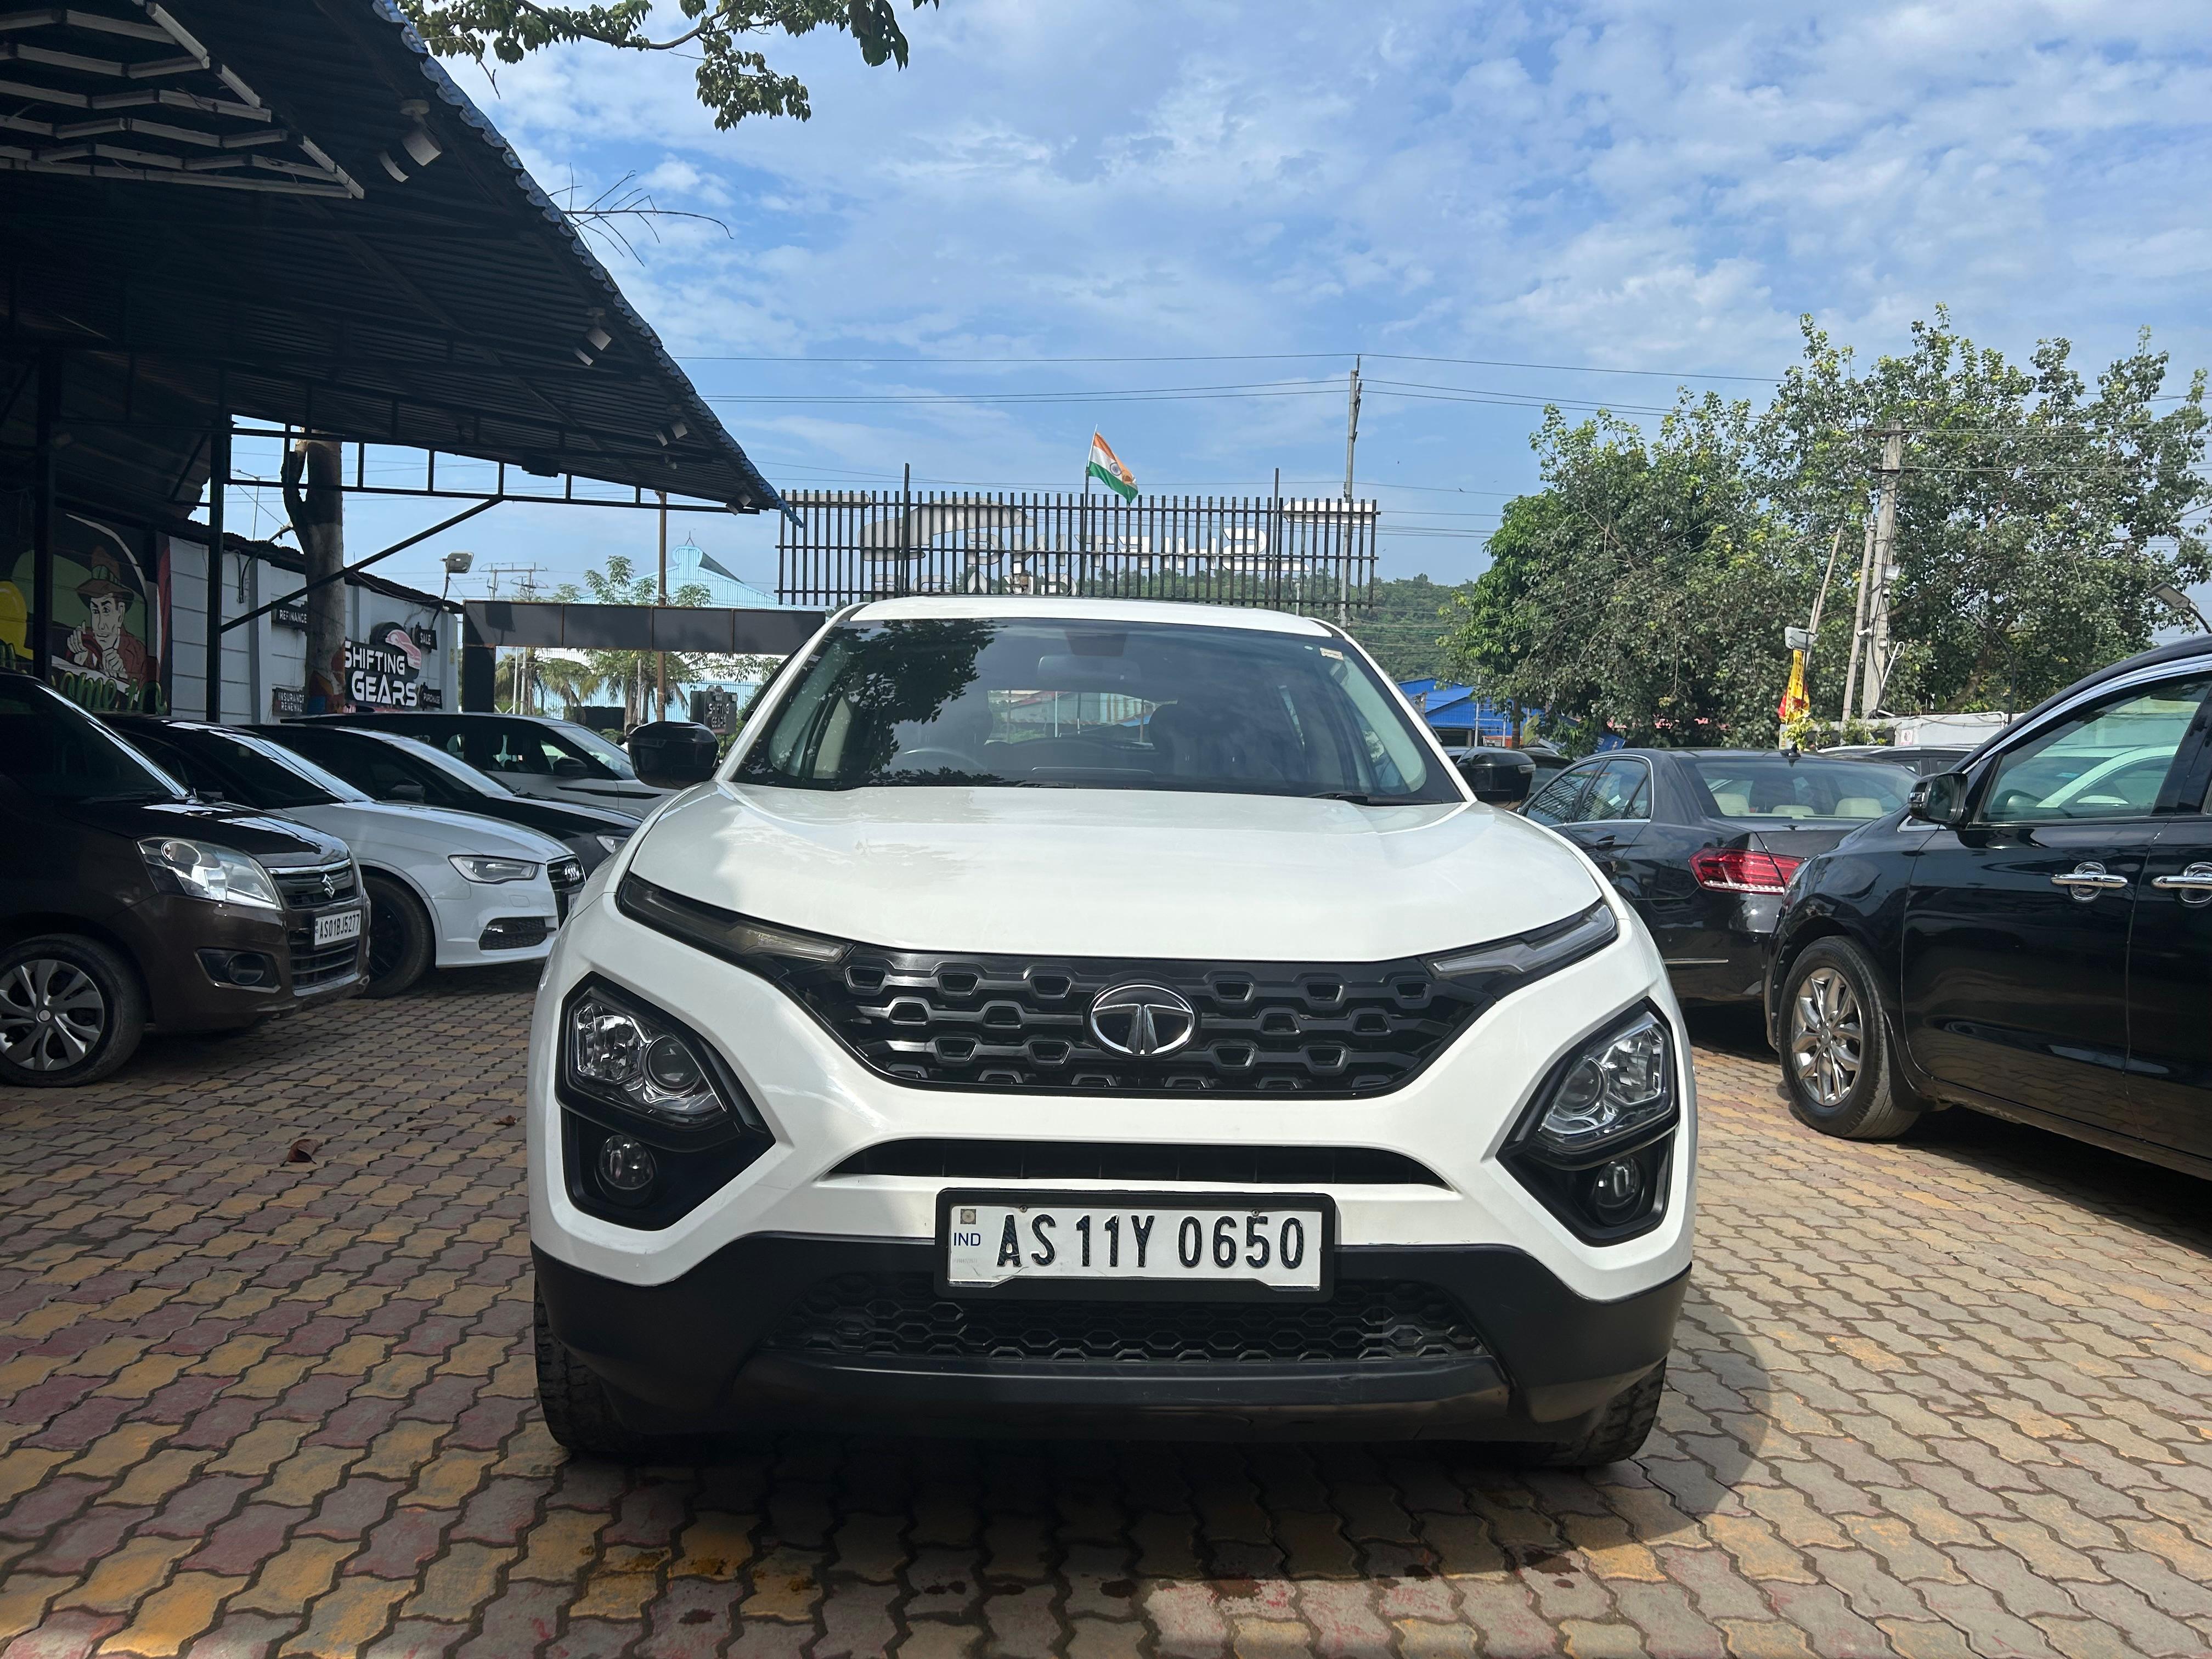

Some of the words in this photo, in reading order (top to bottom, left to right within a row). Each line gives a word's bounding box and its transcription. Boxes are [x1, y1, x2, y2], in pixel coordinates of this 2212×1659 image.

[279, 609, 307, 624] REFINANCE
[420, 632, 431, 645] SALE
[345, 640, 405, 675] SHIFTING
[351, 670, 417, 707] GEARS
[319, 913, 360, 940] AS01BJ5277
[953, 1232, 981, 1246] IND
[997, 1214, 1057, 1267] AS
[1076, 1215, 1154, 1267] 11Y
[1178, 1216, 1304, 1268] 0650
